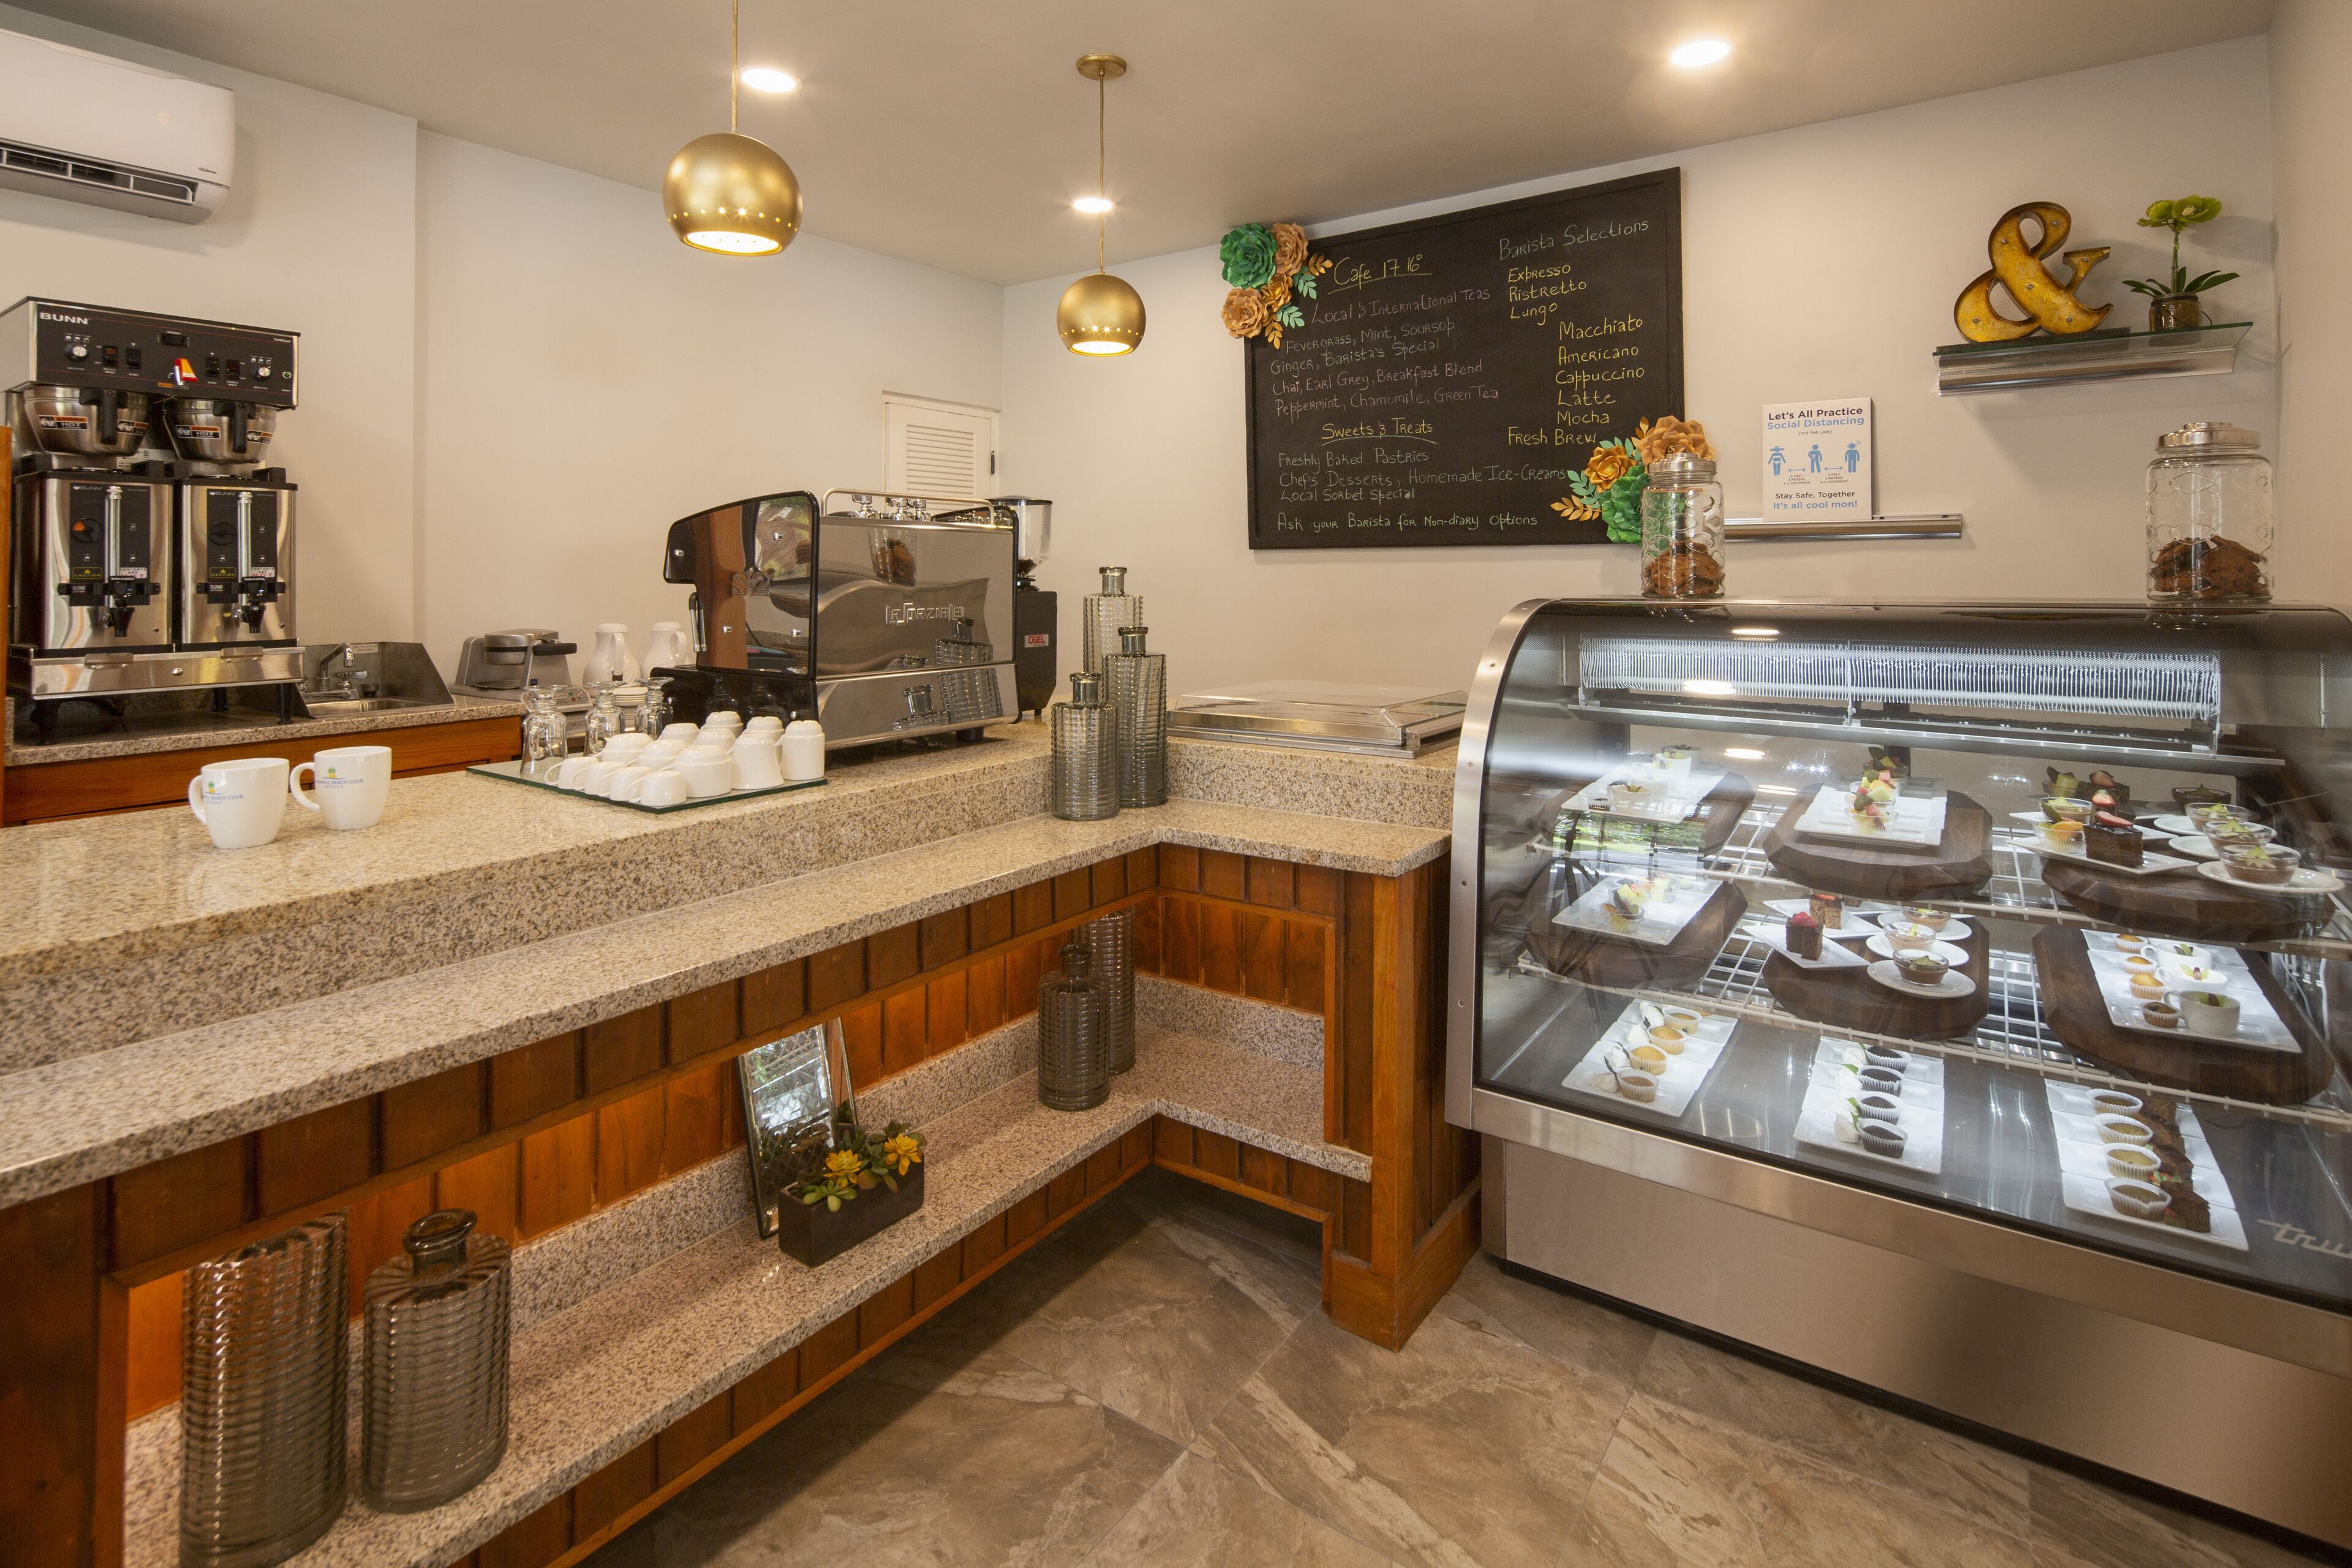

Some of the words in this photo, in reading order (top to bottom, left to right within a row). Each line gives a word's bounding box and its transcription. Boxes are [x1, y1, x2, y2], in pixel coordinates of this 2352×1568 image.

[1499, 233, 1555, 260] Barista
[1563, 220, 1649, 246] Selections
[1333, 257, 1372, 290] Cafe
[1507, 264, 1571, 283] Expresso
[1509, 279, 1586, 303] Ristretto
[1311, 303, 1352, 324] Local
[1367, 290, 1457, 317] International
[1460, 288, 1490, 302] Teas
[1510, 303, 1558, 326] Lungo
[39, 312, 88, 325] BUNN
[1559, 313, 1643, 341] Macchiato
[1286, 336, 1356, 356] Fevergrass,
[1361, 326, 1396, 342] Mint,
[1401, 316, 1455, 337] Soursop
[1270, 360, 1319, 378] Ginger,
[1325, 347, 1385, 367] Barista's
[1392, 337, 1439, 361] Special
[1559, 346, 1638, 366] Americano
[1273, 380, 1303, 396] Chai,
[1306, 374, 1332, 391] Earl
[1336, 371, 1375, 390] Grey,
[1377, 364, 1439, 387] Breakfast
[1446, 359, 1482, 377] Blend
[1556, 367, 1645, 391] Cappuccino
[1275, 396, 1346, 424] Peppermint,
[1351, 389, 1430, 407] Chamomile,
[1434, 387, 1471, 403] Green
[1469, 385, 1498, 399] Tea
[1558, 390, 1616, 406] Latte
[1557, 410, 1610, 426] Mocha
[1767, 420, 1800, 429] Social
[1804, 417, 1864, 428] Distancing
[1768, 412, 1795, 420] Let's
[1798, 410, 1812, 418] All
[1817, 407, 1863, 417] Practice
[1321, 421, 1374, 439] Sweets
[1391, 417, 1433, 435] Treats
[1509, 426, 1548, 445] Fresh
[1555, 429, 1596, 446] Brew
[1279, 453, 1321, 474] Freshly
[1327, 451, 1363, 466] Baked
[1373, 447, 1429, 464] Pastries
[1279, 472, 1318, 489] Chef's
[1325, 470, 1401, 488] Desserts,
[1409, 467, 1482, 484] Homemade
[1483, 464, 1566, 481] Ice-Creams
[1281, 489, 1317, 503] Local
[1324, 488, 1365, 501] Sorbet
[1278, 512, 1303, 531] Ask
[1313, 521, 1339, 533] your
[1348, 512, 1391, 528] Barista
[1397, 513, 1417, 531] for
[1424, 511, 1479, 530] Non-diary
[1489, 512, 1537, 530] Options
[2255, 1218, 2352, 1260] tru
